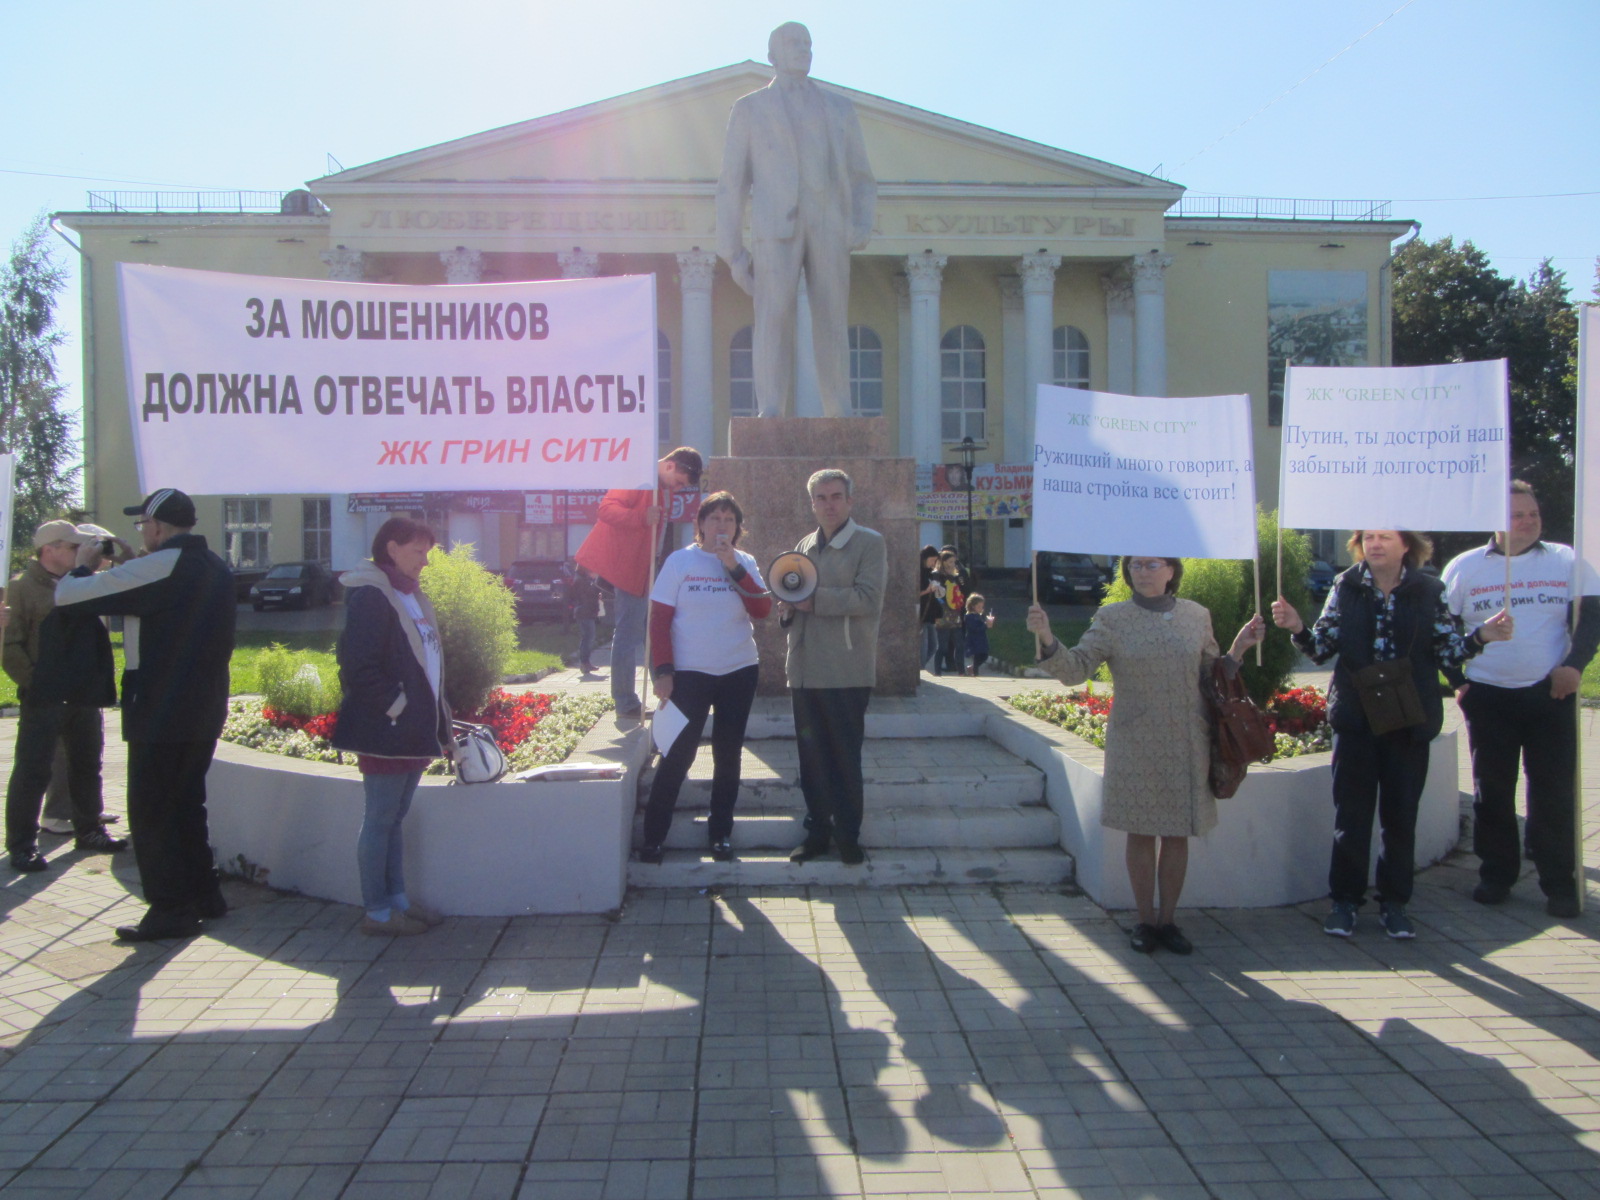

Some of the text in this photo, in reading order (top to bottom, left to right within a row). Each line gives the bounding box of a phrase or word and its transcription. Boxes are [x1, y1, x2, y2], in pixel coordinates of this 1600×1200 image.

[360, 209, 687, 232] ЛЮБЕРЕЦКИЙ
[906, 214, 1136, 236] КУЛЬТУРЫ
[245, 297, 550, 341] ЗА МОШЕННИКОВ
[142, 372, 646, 422] ДОЛЖНА ОТВЕЧАТЬ ВЛАСТЬ!
[1306, 384, 1461, 402] ЖК "GREEN CITY"
[1067, 412, 1197, 434] ЖК "GREEN CITY"
[1286, 424, 1505, 449] Путин, ты дострой наш
[377, 437, 631, 465] ЖК ГРИН СИТИ
[1034, 444, 1253, 477] Ружицкий много говорит, а
[995, 463, 1034, 474] Владими
[1288, 453, 1487, 479] забытый долгострой!
[976, 475, 1034, 491] КУЗЬМИ
[1042, 477, 1236, 501] наша стройка все стоит!
[1473, 599, 1492, 612] ЖК
[1496, 596, 1534, 608] «рин
